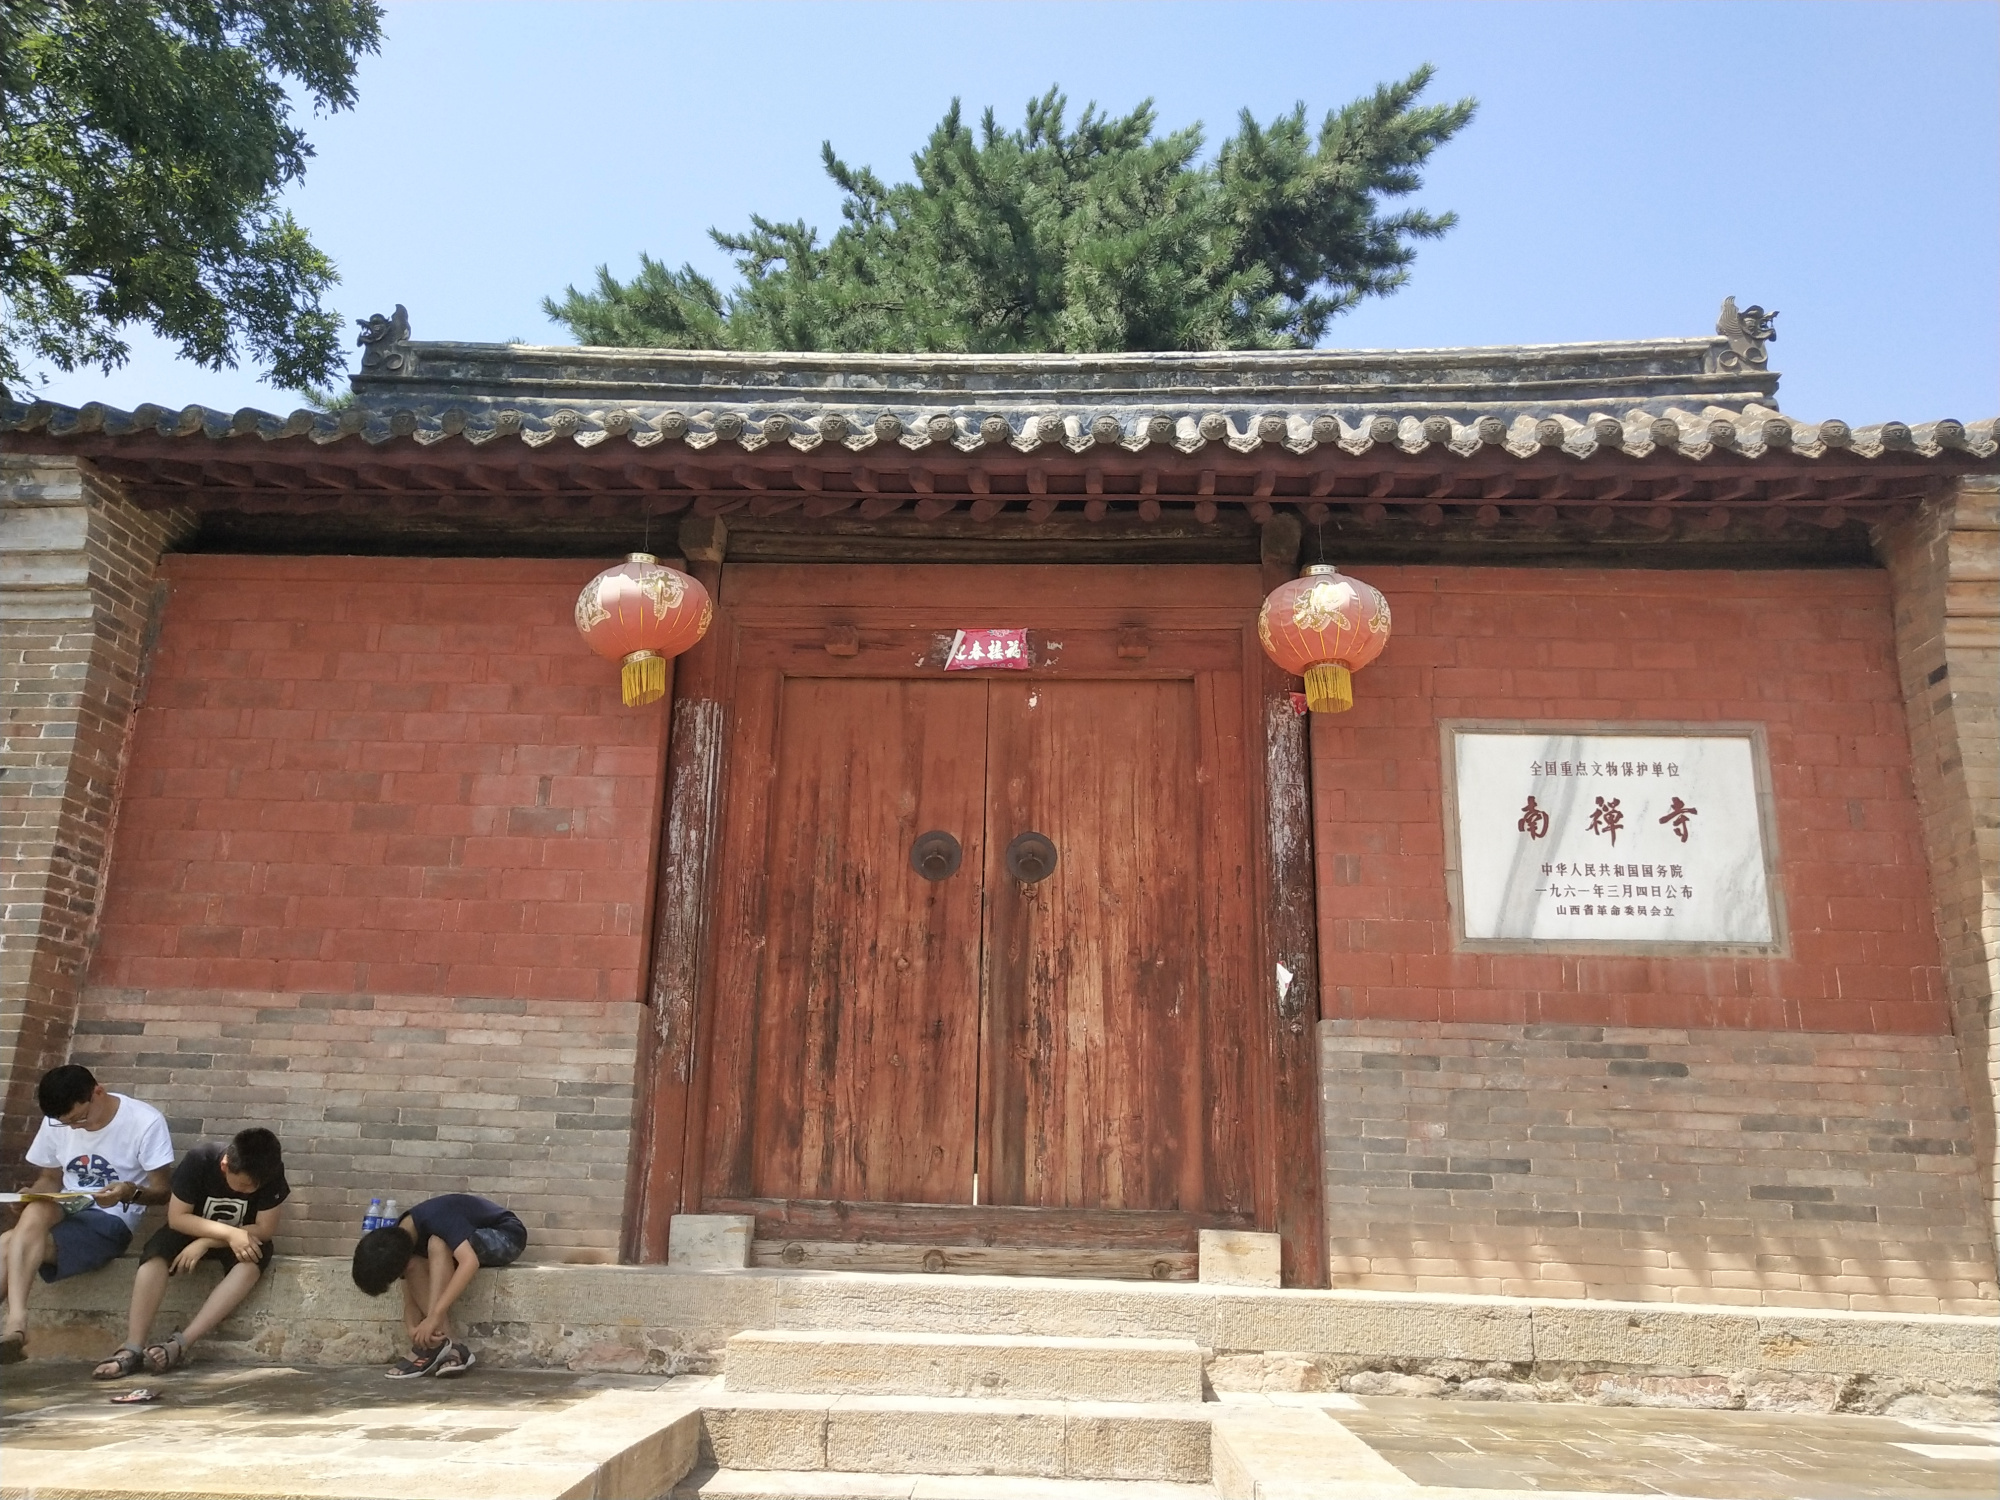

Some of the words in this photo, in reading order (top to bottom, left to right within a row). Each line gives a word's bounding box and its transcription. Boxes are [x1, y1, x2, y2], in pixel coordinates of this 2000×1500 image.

[1530, 761, 1680, 777] 全国重点文物保护单位
[1541, 862, 1684, 879] 中华人民共和国国务院
[1535, 883, 1693, 900] 一九六一年三月四日公布
[1556, 904, 1675, 917] 山西省革命委员会立
